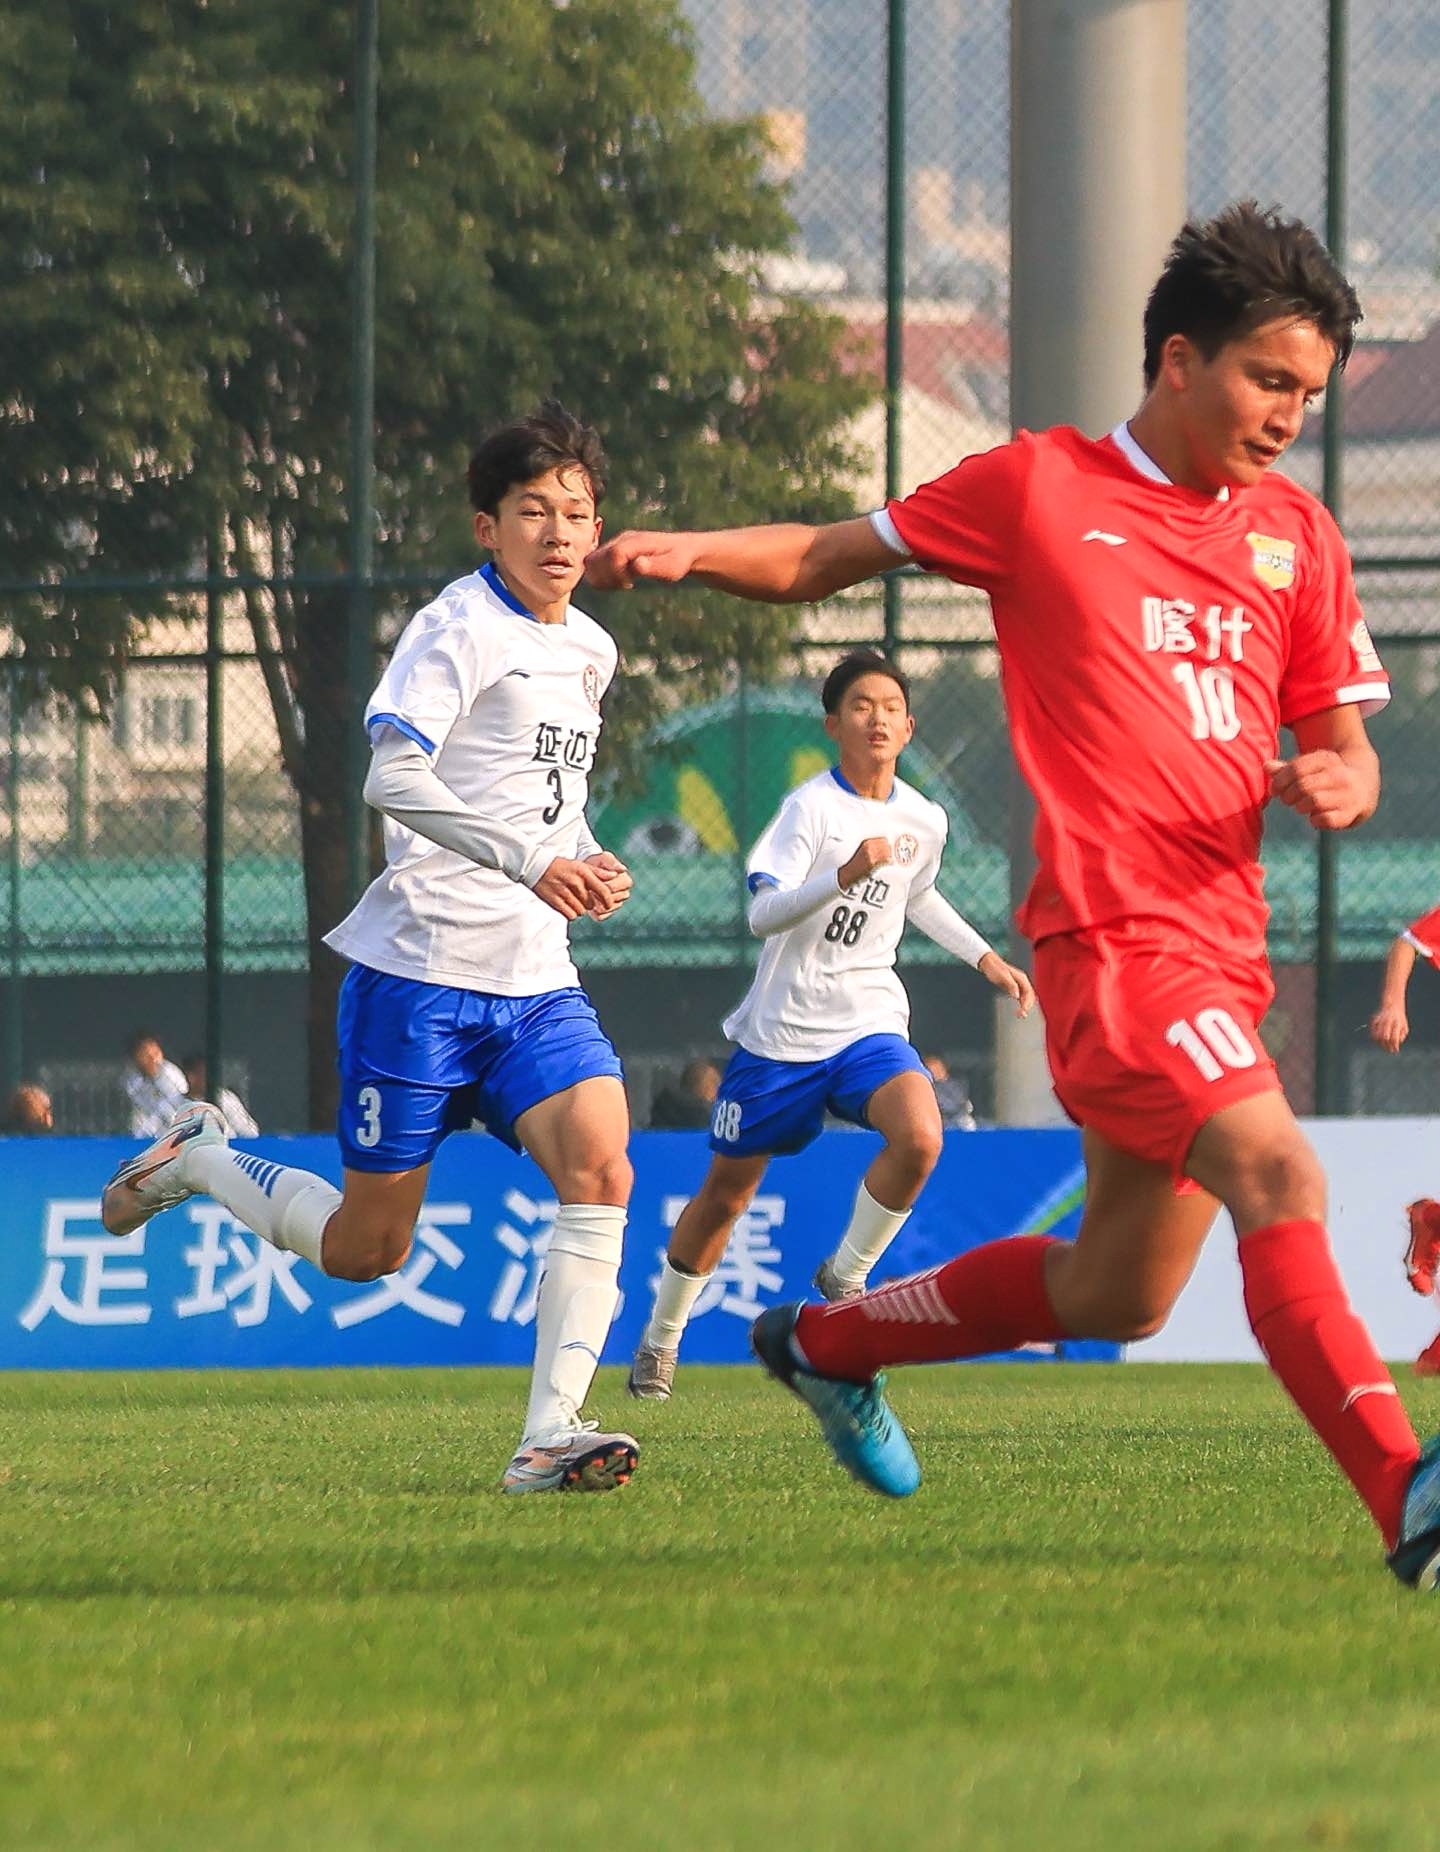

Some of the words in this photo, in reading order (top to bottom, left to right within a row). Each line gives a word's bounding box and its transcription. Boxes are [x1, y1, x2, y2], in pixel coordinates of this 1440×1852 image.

[1141, 596, 1254, 662] 喀什
[1172, 662, 1242, 742] 10
[532, 722, 589, 771] 延边
[542, 768, 565, 825] 3
[824, 905, 869, 946] 88
[1166, 1007, 1257, 1082] 10
[356, 1086, 382, 1148] 3
[714, 1100, 743, 1142] 88
